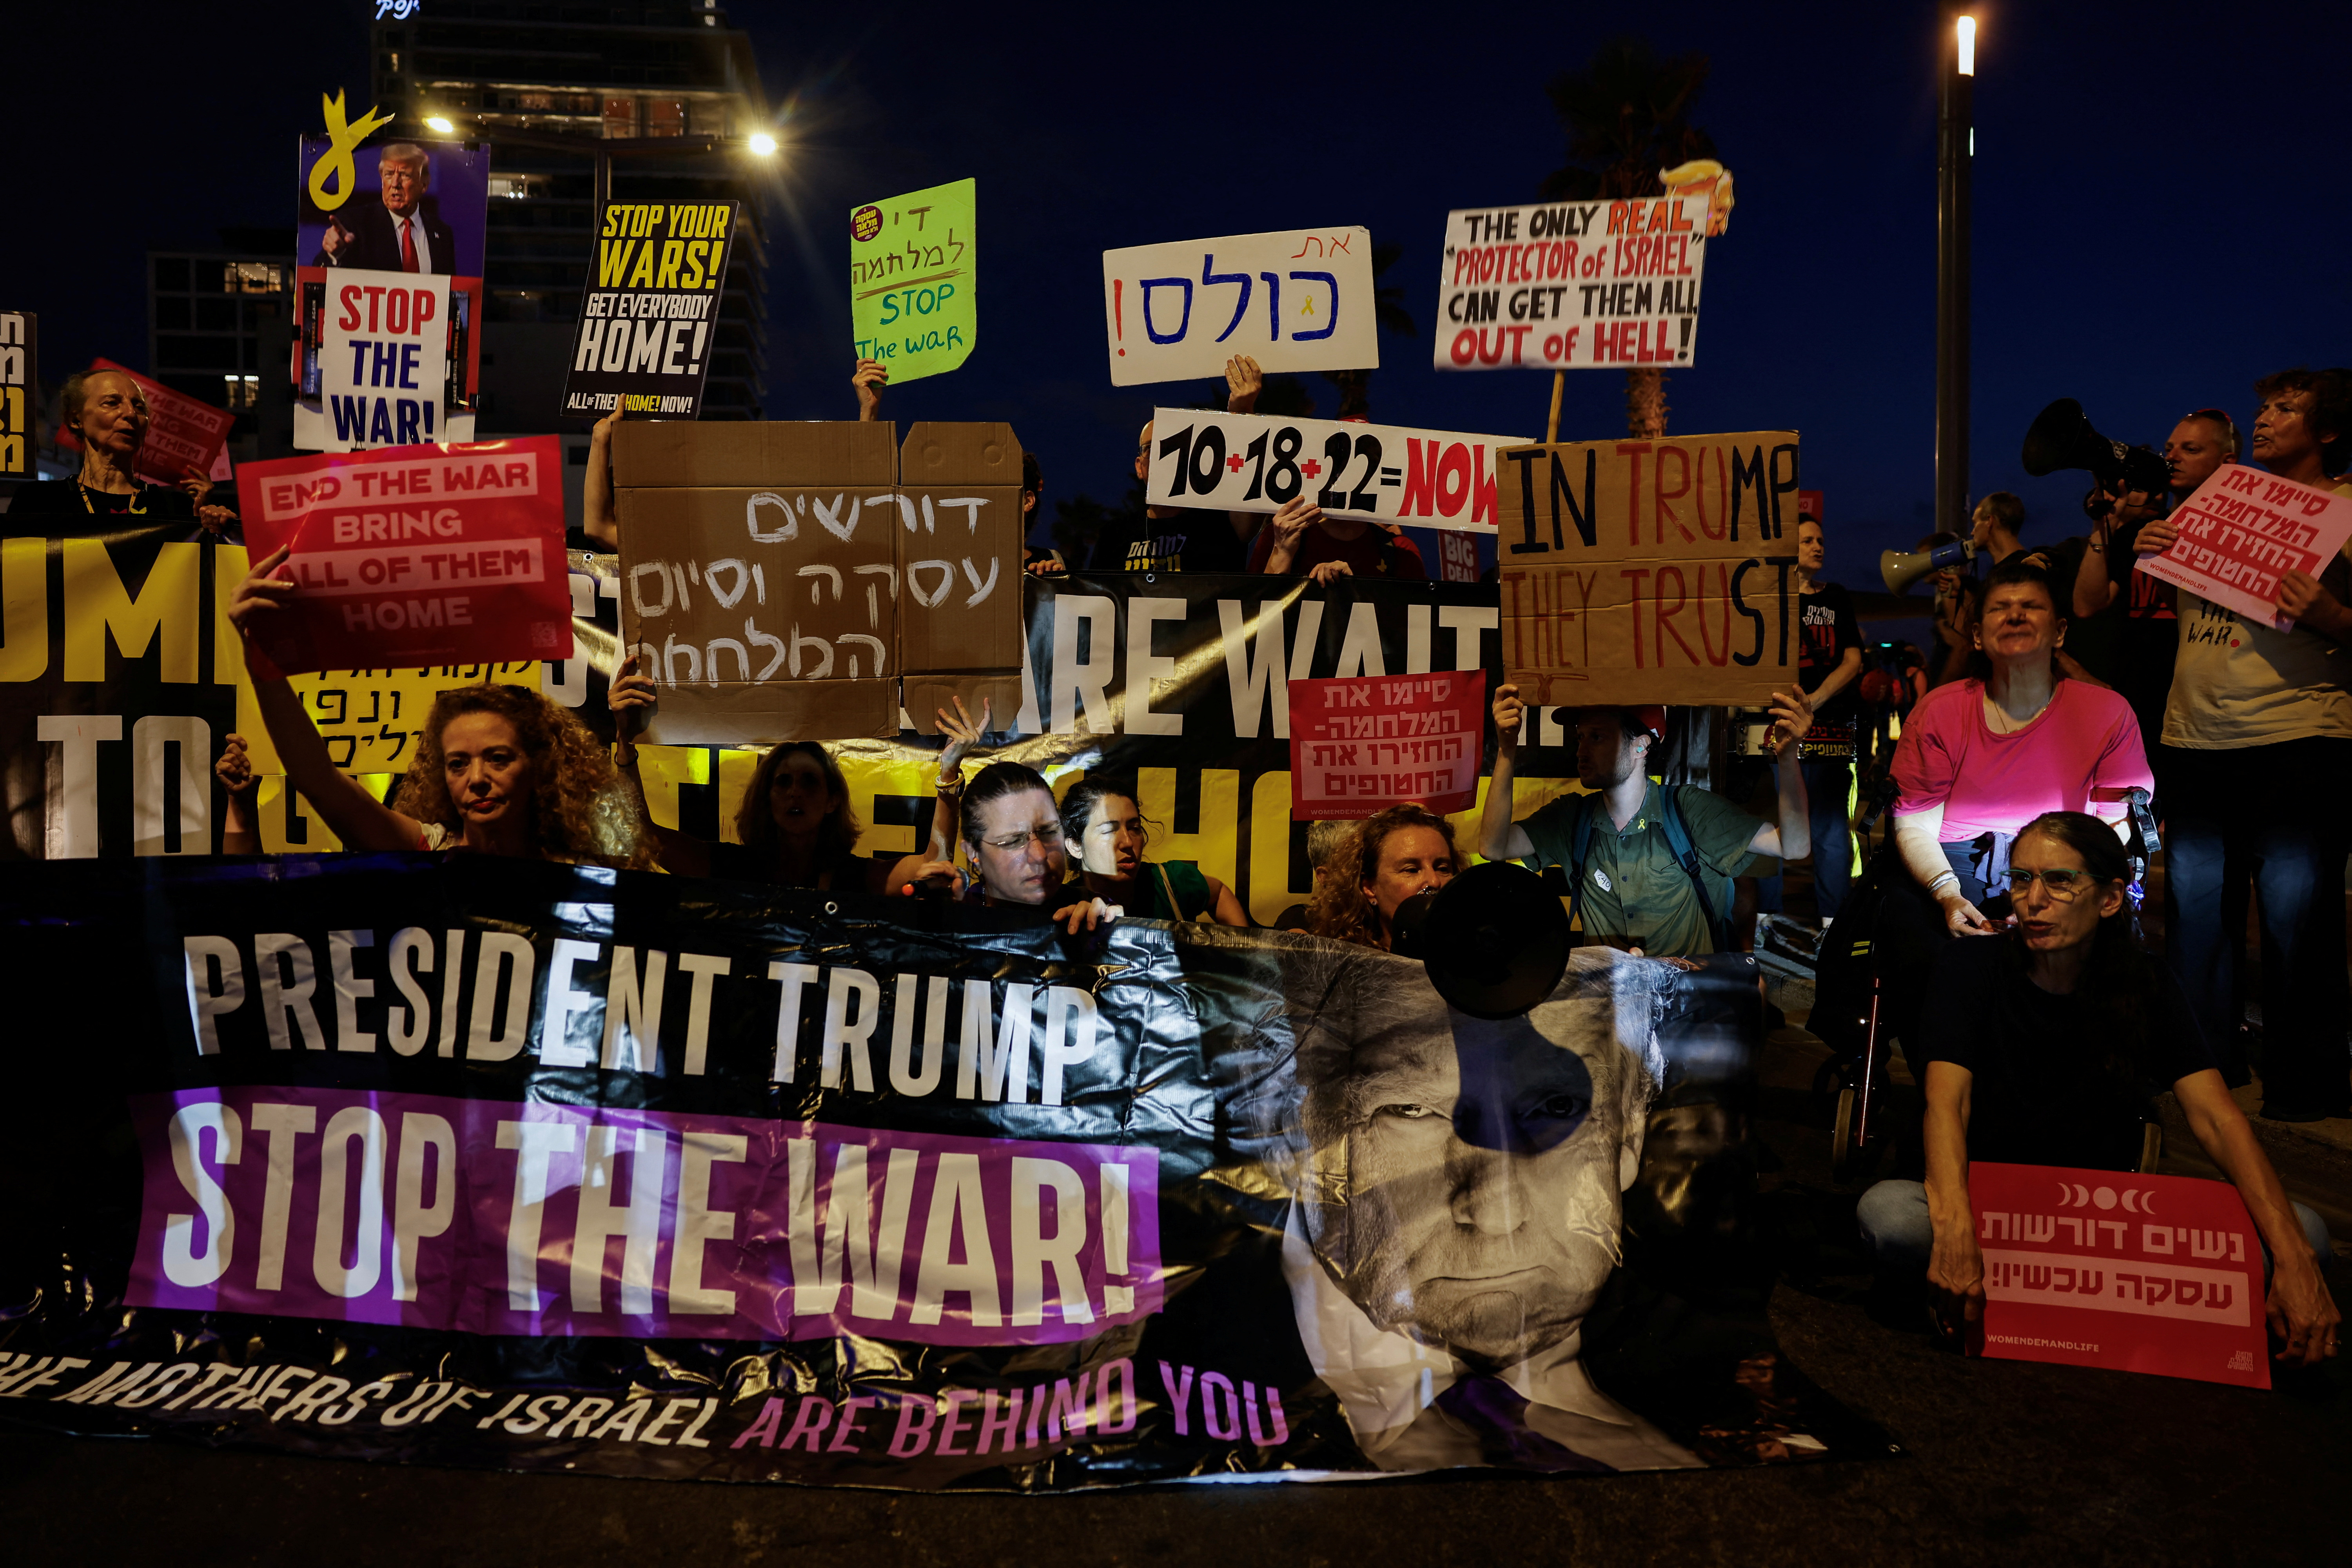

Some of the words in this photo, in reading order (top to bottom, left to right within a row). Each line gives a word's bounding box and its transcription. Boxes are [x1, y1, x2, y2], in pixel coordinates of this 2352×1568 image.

[603, 205, 664, 237] STOP
[668, 205, 730, 238] YOUR
[855, 209, 876, 224] עסקה
[857, 218, 877, 232] מלאה
[895, 206, 935, 231] די
[1465, 213, 1519, 243] THE
[1529, 203, 1601, 237] ONLY
[1607, 200, 1694, 234] REAL
[852, 227, 964, 284] למלחמה
[1291, 233, 1350, 258] את
[599, 240, 724, 289] WARS!
[339, 285, 436, 336] STOP
[586, 293, 618, 317] GET
[617, 294, 713, 319] EVERYBODY
[879, 284, 955, 325] STOP
[1448, 290, 1500, 324] CAN
[1509, 287, 1567, 320] GET
[1579, 283, 1652, 318] THEM
[1658, 278, 1697, 314] ALL
[575, 319, 708, 374] HOME!
[1450, 325, 1533, 365] OUT
[1593, 318, 1693, 363] HELL!
[349, 340, 421, 389] THE
[179, 406, 218, 429] WAR
[330, 394, 434, 444] WAR!
[567, 392, 587, 409] ALL
[587, 397, 595, 406] OF
[625, 394, 661, 412] HOME!
[661, 396, 693, 413] NOW!
[156, 432, 201, 459] THEM
[270, 476, 341, 512] END
[353, 468, 432, 497] THE
[443, 463, 530, 492] WAR
[1506, 448, 1597, 554] IN
[1616, 442, 1798, 546] TRUMP
[2220, 469, 2263, 495] את
[2262, 481, 2330, 517] סיימו
[333, 508, 463, 544] BRING
[747, 492, 992, 543] דורשים
[2177, 510, 2217, 539] את
[1445, 534, 1474, 567] BIG
[2216, 521, 2305, 569] החזירו
[359, 557, 410, 584] OF
[421, 549, 531, 581] THEM
[2149, 563, 2208, 592] WOMENDEMANDLIFE
[2169, 537, 2278, 597] החטופים
[628, 558, 766, 617] וסיום
[796, 556, 998, 629] עסקה
[343, 596, 473, 632] HOME
[1503, 570, 1597, 669] THEY
[1620, 556, 1799, 669] TRUST
[1324, 685, 1370, 708] את
[1381, 679, 1451, 705] סיימו
[1313, 744, 1357, 766] את
[1367, 737, 1462, 765] החזירו
[37, 715, 211, 860] TO
[1325, 769, 1453, 796] החטופים
[184, 927, 731, 1076] PRESIDENT
[768, 961, 1099, 1106] TRUMP
[162, 1102, 457, 1302] STOP
[495, 1120, 749, 1315] THE
[788, 1138, 1135, 1327] WAR!
[1982, 1211, 2128, 1250] דורשות
[2142, 1225, 2245, 1262] נשים
[1992, 1262, 2103, 1296] עכשיו!
[2116, 1272, 2233, 1310] עסקה
[1987, 1334, 2100, 1352] WOMENDEMANDLIFE
[50, 1360, 388, 1425] MOTHERS
[381, 1381, 494, 1426] OF
[477, 1394, 719, 1449] ISRAEL
[730, 1396, 880, 1453] ARE
[887, 1357, 1136, 1458] BEHIND
[1157, 1359, 1290, 1447] YOU
